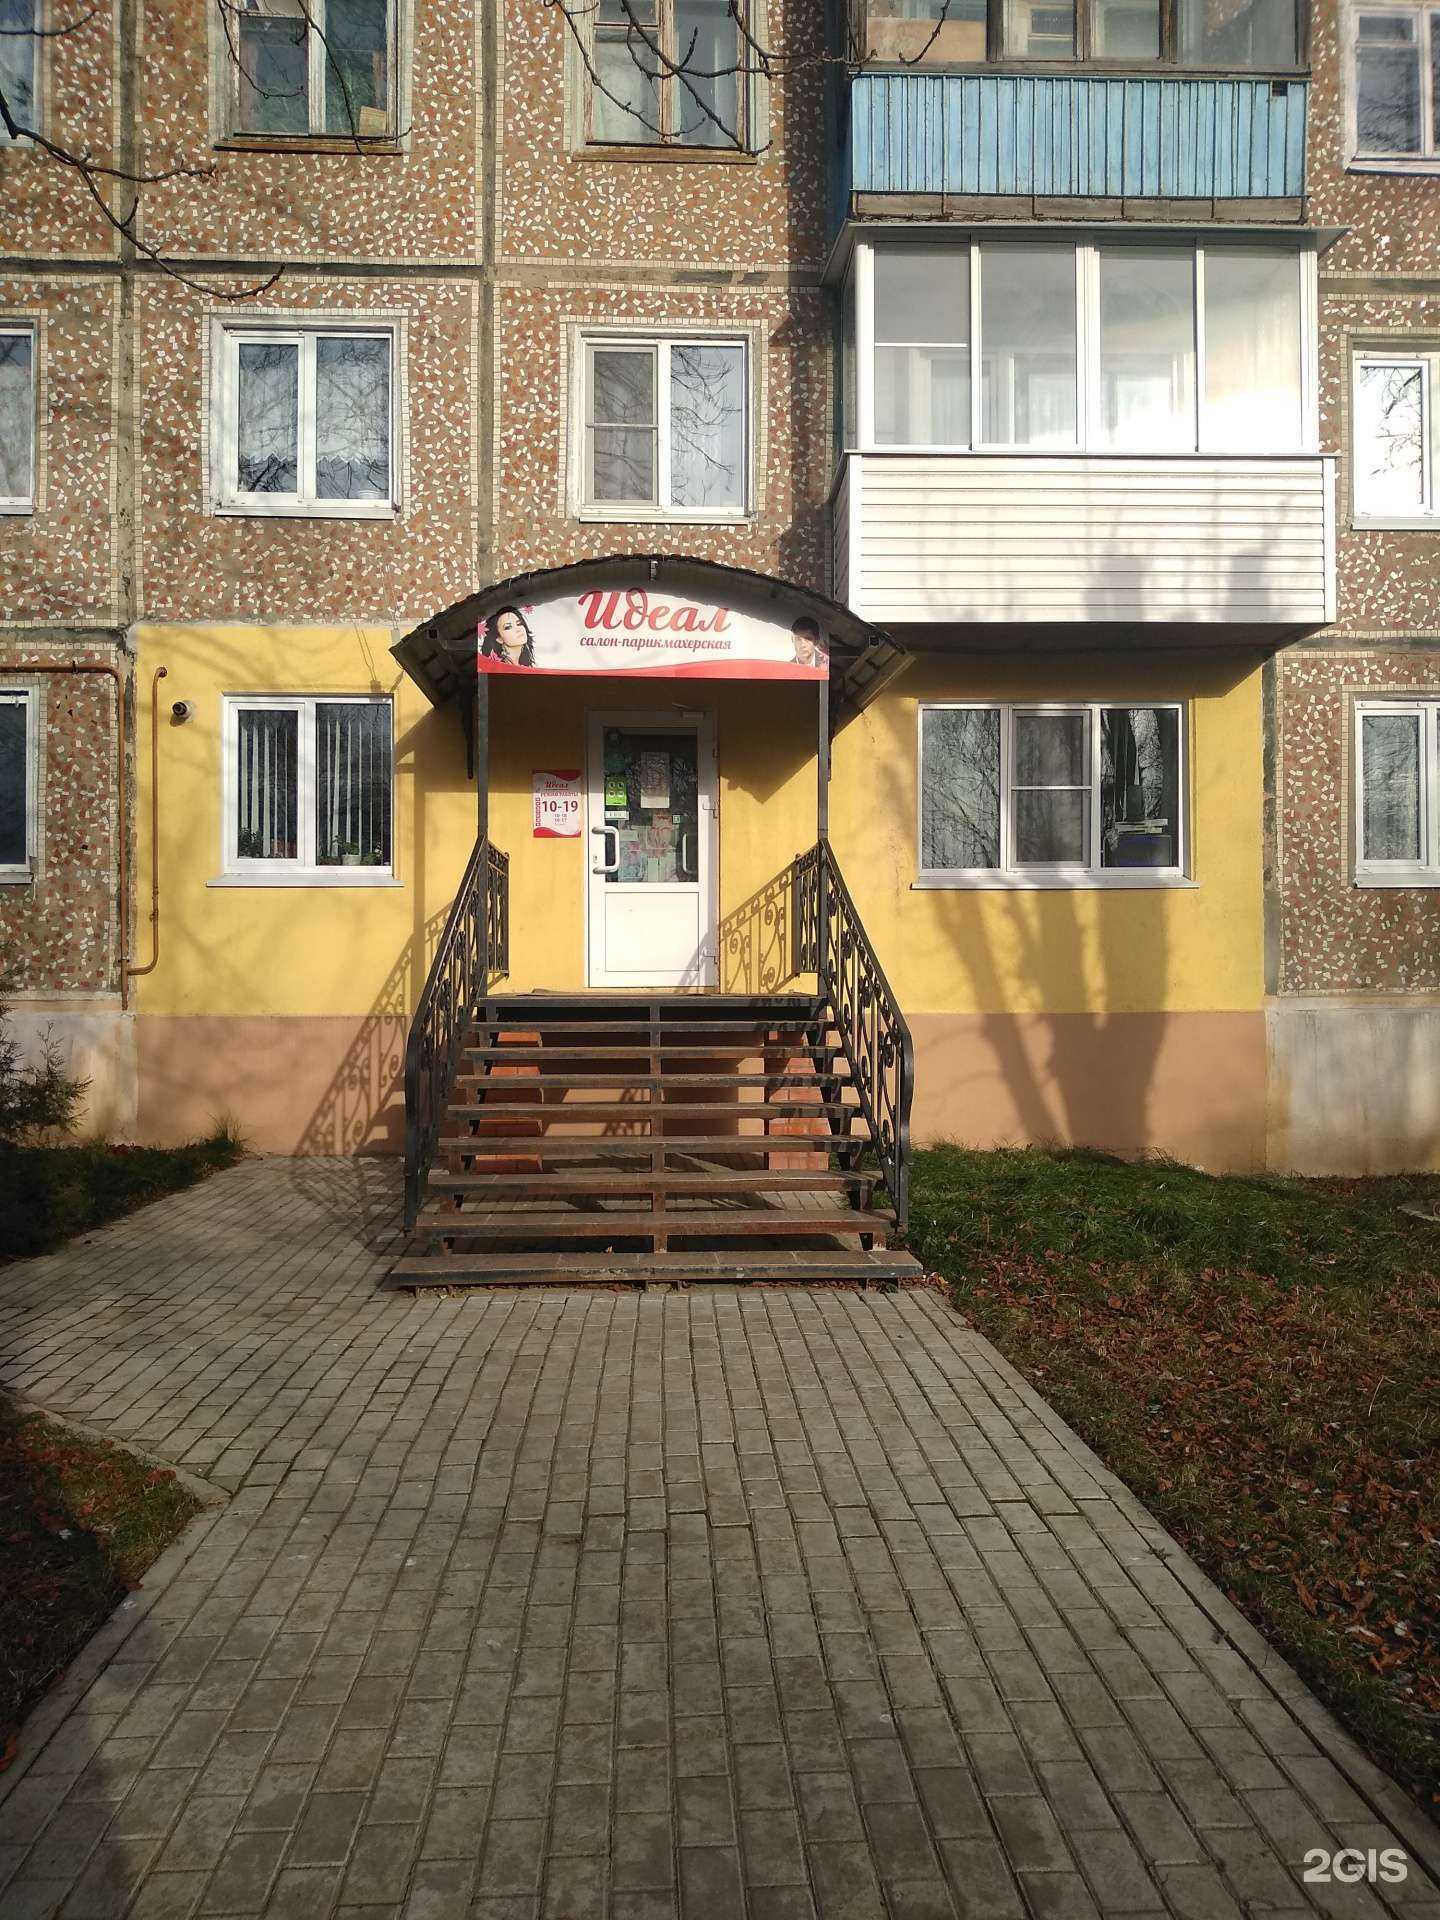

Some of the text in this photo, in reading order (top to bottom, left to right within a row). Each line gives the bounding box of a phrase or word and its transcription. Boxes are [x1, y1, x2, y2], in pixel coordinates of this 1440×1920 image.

[577, 587, 732, 632] Идеал
[579, 635, 732, 653] салон-парикмахерская
[542, 800, 579, 812] 10-19
